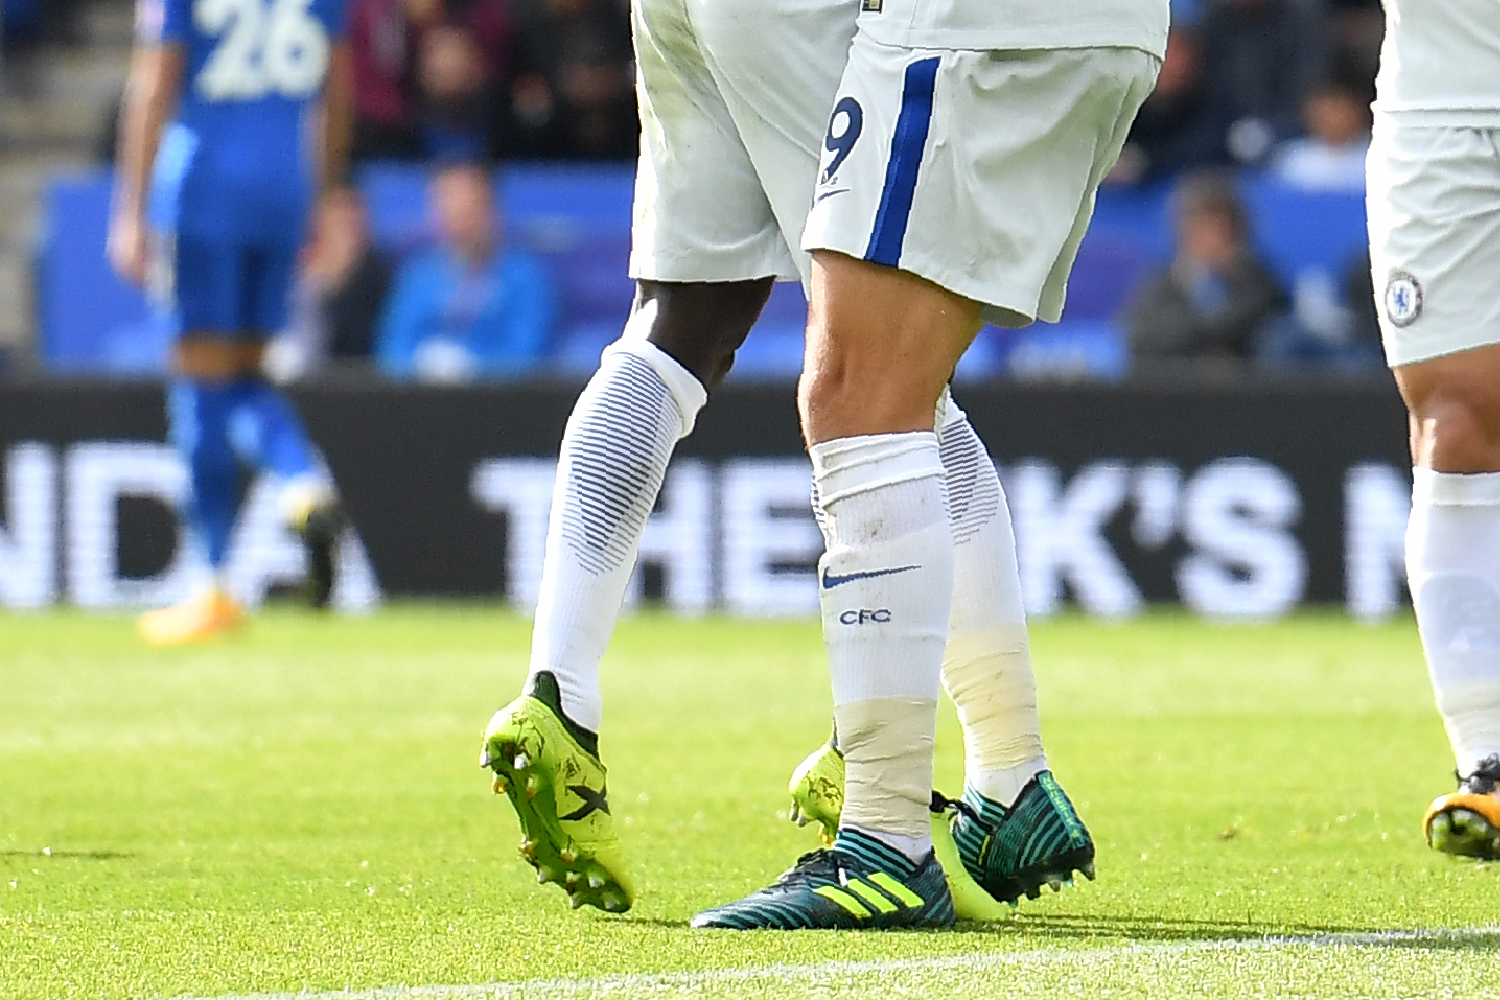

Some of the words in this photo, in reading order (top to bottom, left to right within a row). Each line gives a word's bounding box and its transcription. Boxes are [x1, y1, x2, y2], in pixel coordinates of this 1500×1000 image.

[821, 97, 864, 184] 9
[1003, 457, 1305, 622] K'S
[840, 609, 891, 625] CFC
